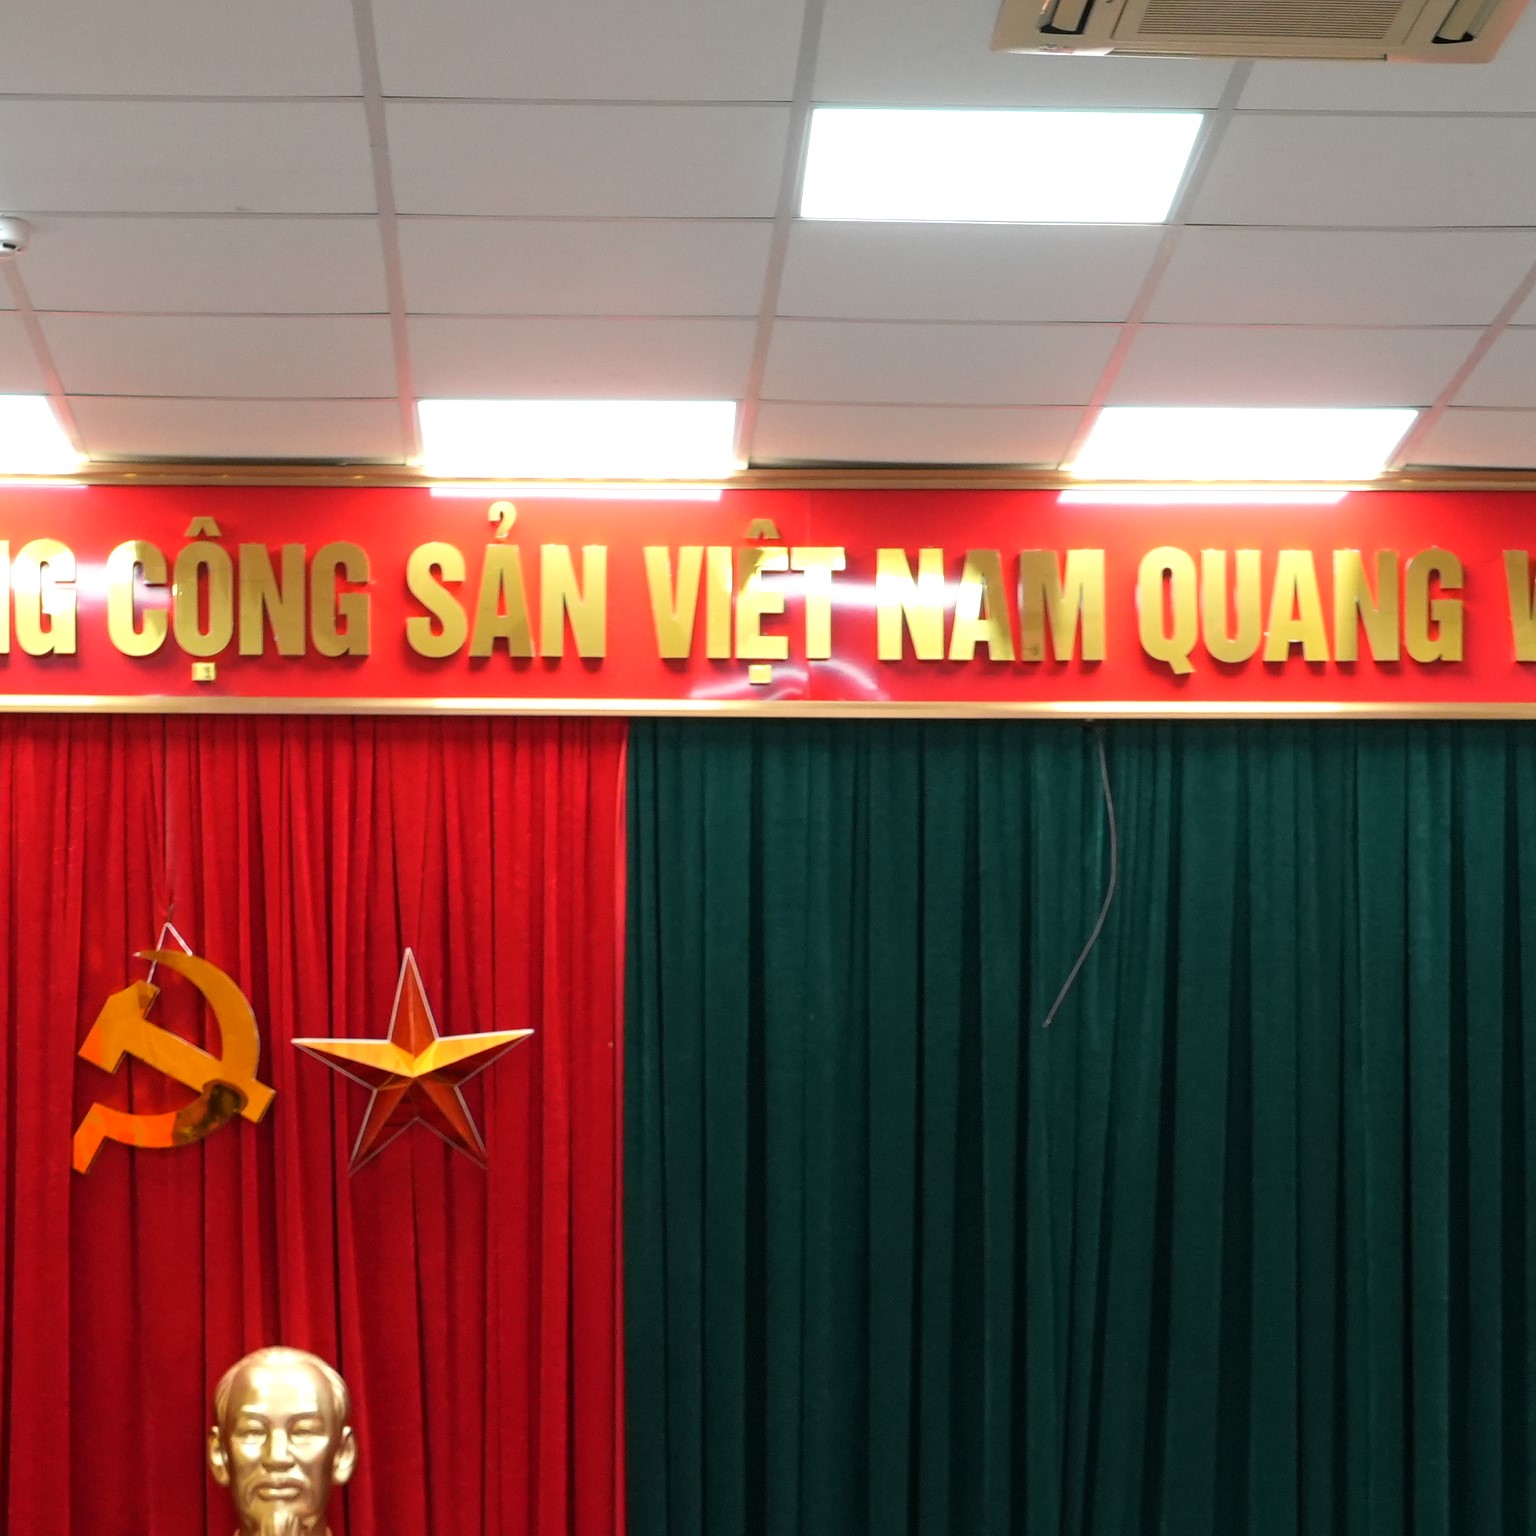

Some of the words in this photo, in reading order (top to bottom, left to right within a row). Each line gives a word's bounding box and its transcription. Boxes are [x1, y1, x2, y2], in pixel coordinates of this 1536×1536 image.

[106, 516, 371, 682] CỘNG
[406, 500, 607, 659] SẢN
[643, 518, 846, 684] VIỆT
[875, 548, 1106, 662] NAM
[1136, 546, 1464, 675] QUANG
